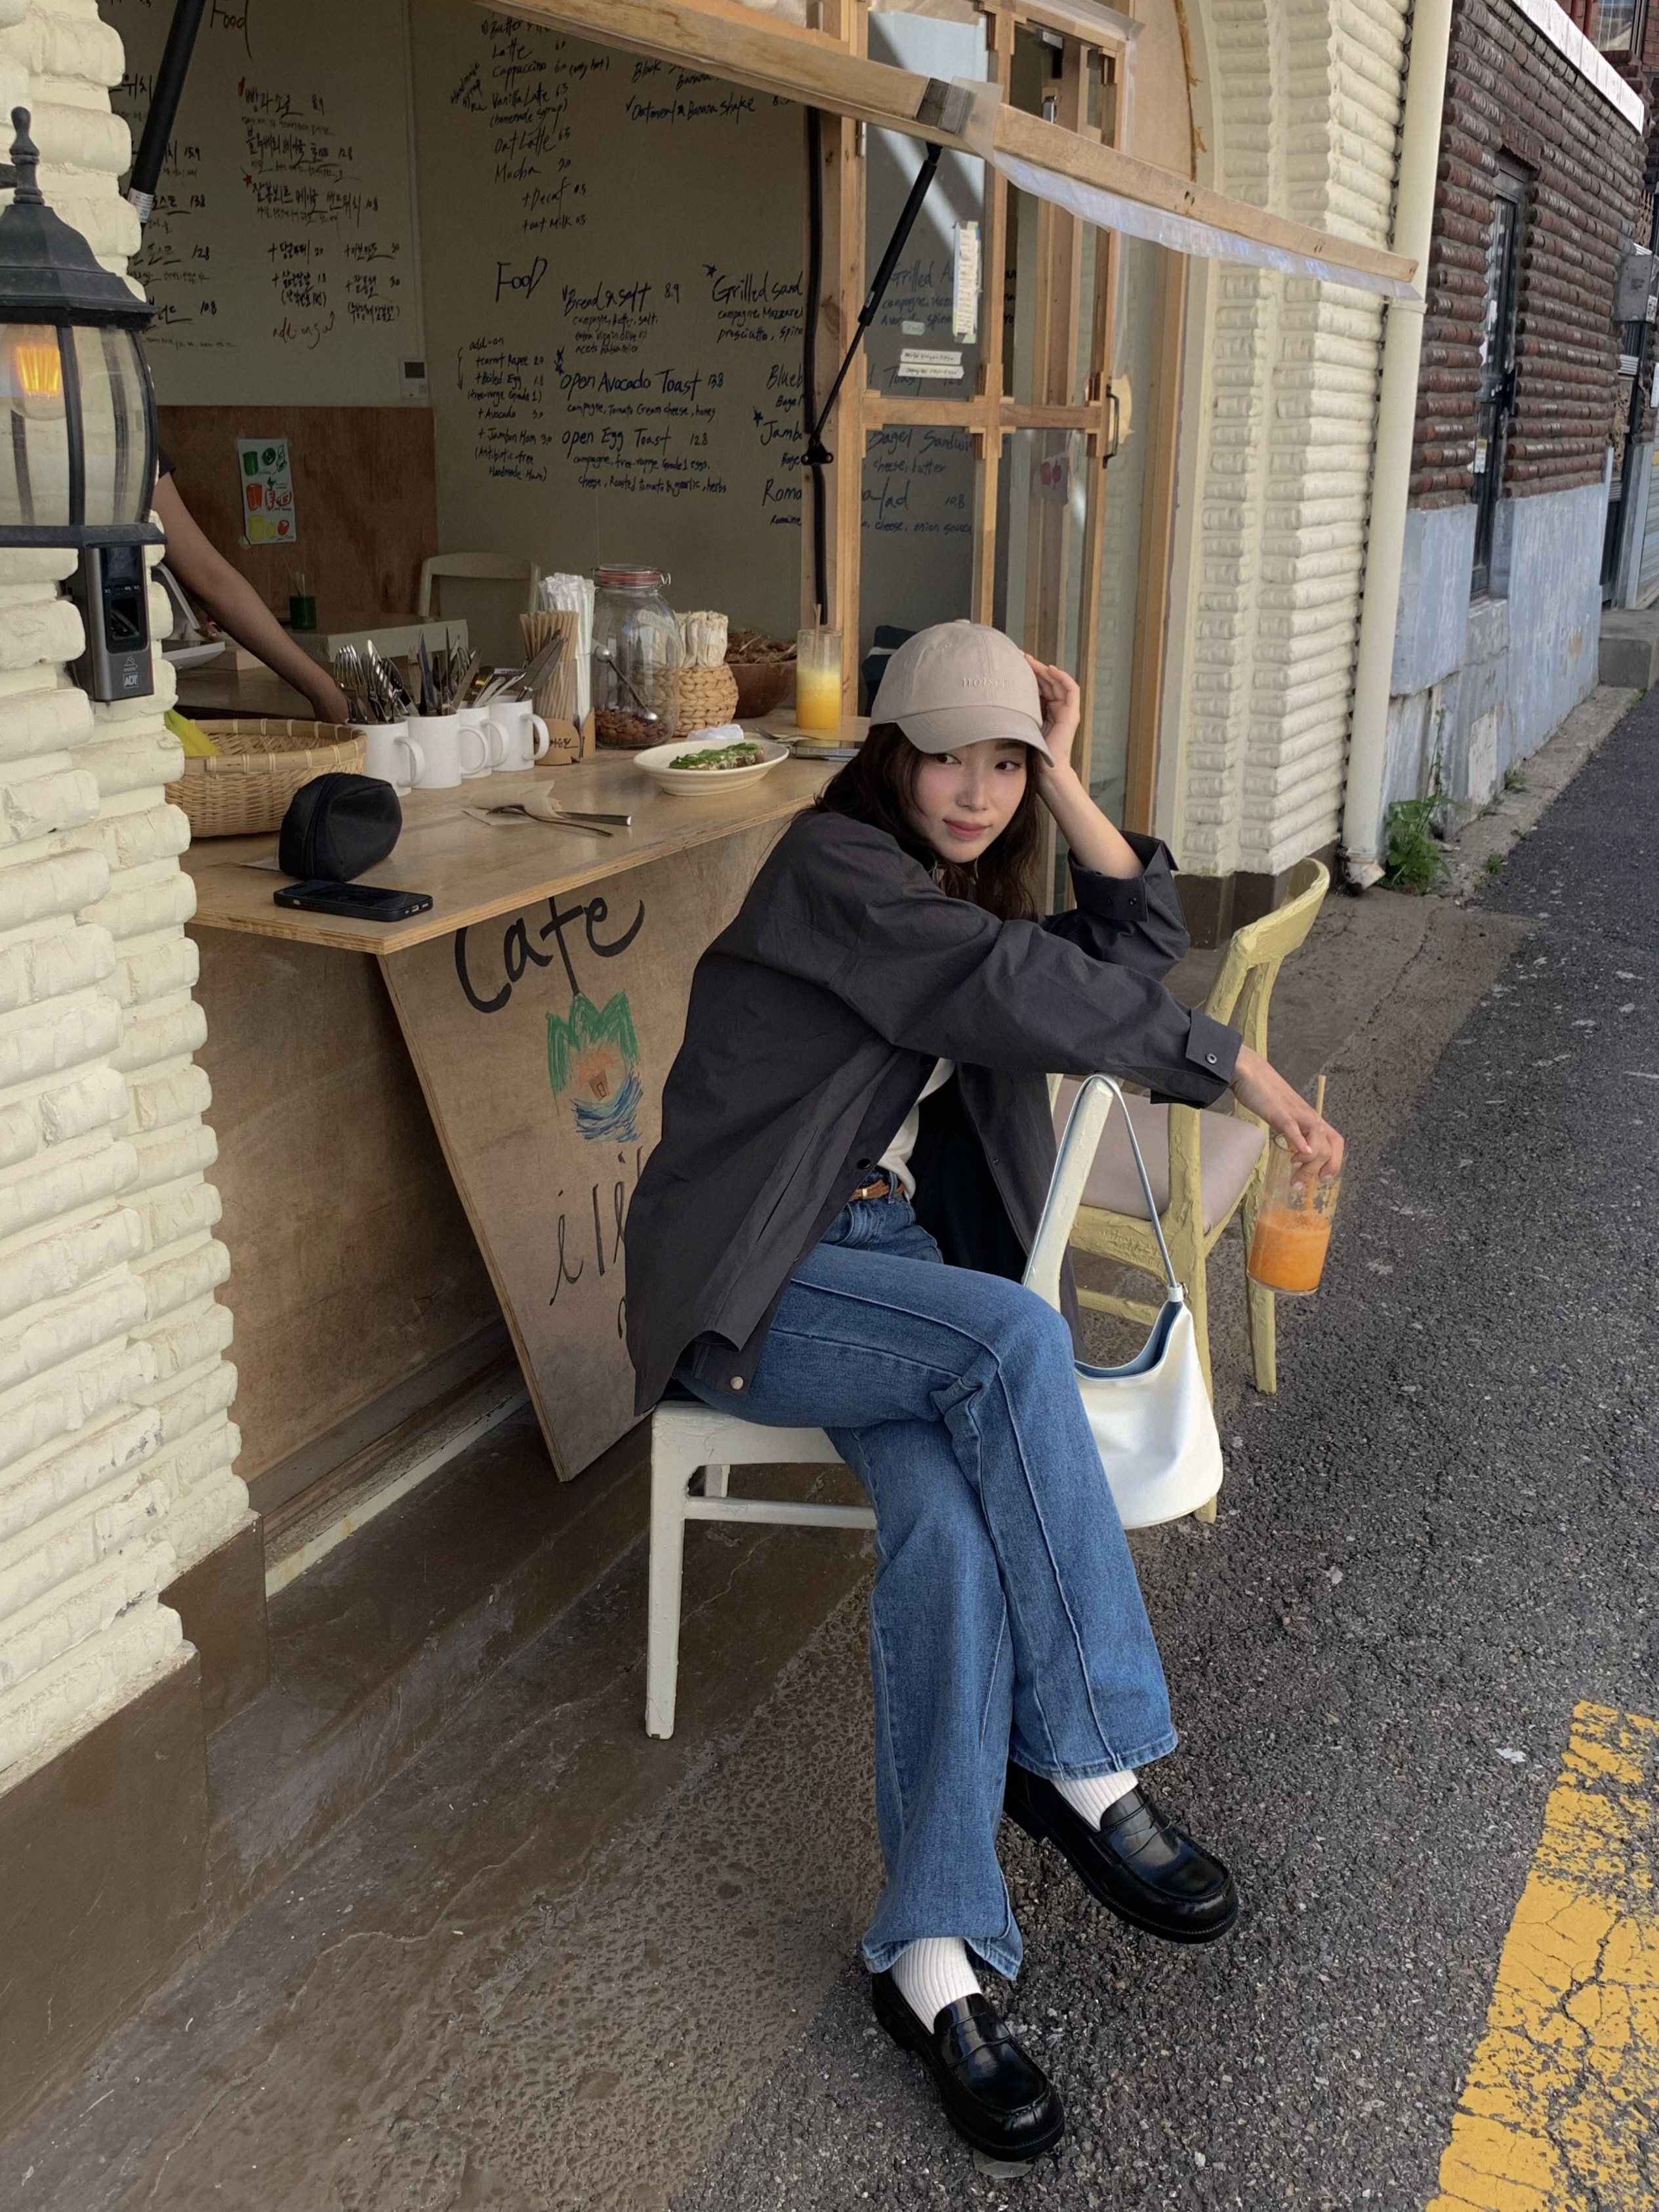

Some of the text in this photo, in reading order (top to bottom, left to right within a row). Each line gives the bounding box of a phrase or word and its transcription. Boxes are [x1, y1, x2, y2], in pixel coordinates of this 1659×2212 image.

[493, 37, 532, 62] Latte
[495, 157, 543, 184] Mocha
[565, 281, 605, 318] Bread
[712, 270, 768, 304] Grilled
[598, 368, 651, 394] Avocado
[655, 368, 702, 402] Toast
[696, 403, 716, 423] honey
[602, 427, 623, 453] Egg
[634, 425, 672, 456] Toast
[945, 493, 965, 509] 10.8
[125, 675, 138, 686] ADT
